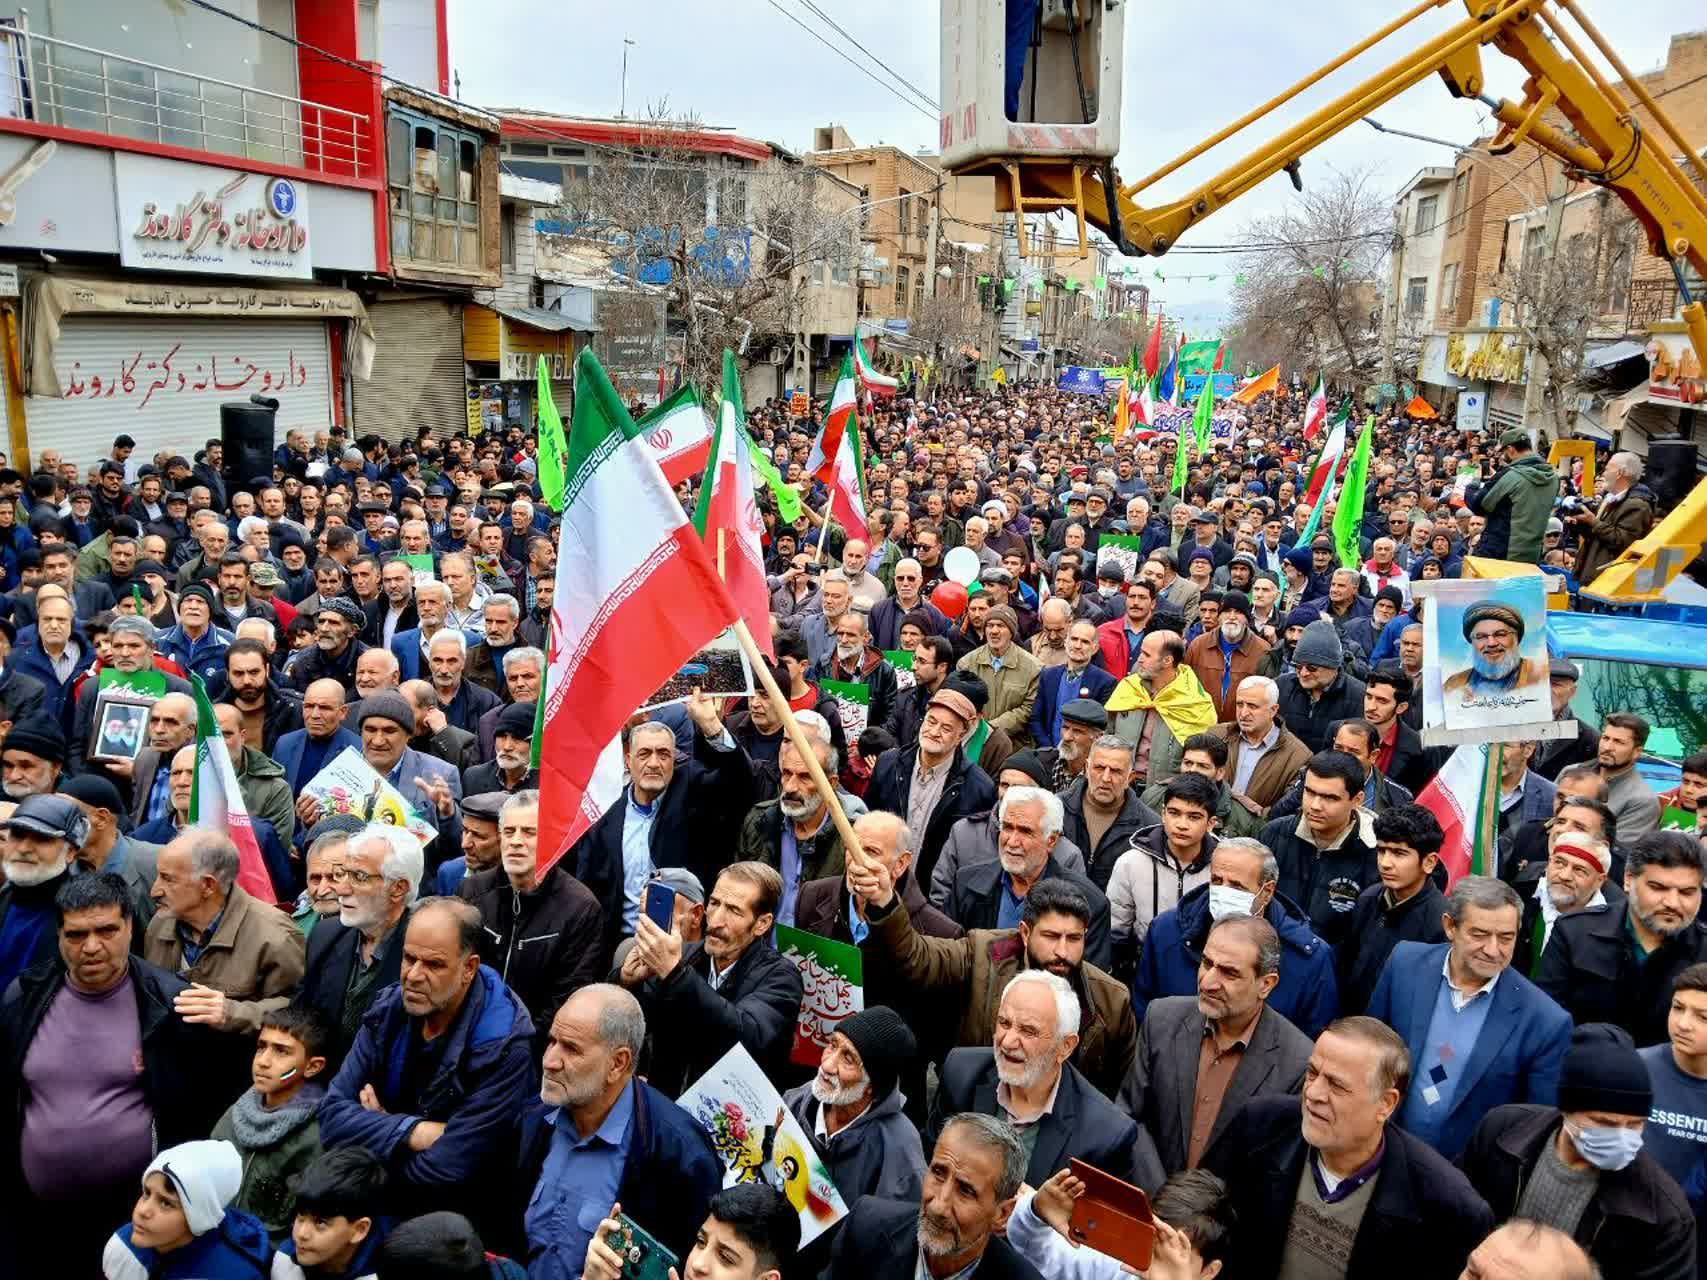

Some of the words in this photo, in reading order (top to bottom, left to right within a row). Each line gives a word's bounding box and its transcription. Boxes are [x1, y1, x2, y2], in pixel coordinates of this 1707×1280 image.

[186, 173, 249, 254] دکتر
[231, 207, 306, 254] داروخانه
[64, 351, 143, 400] کاروند
[137, 343, 186, 410] دکتر
[193, 347, 307, 393] داروخانه
